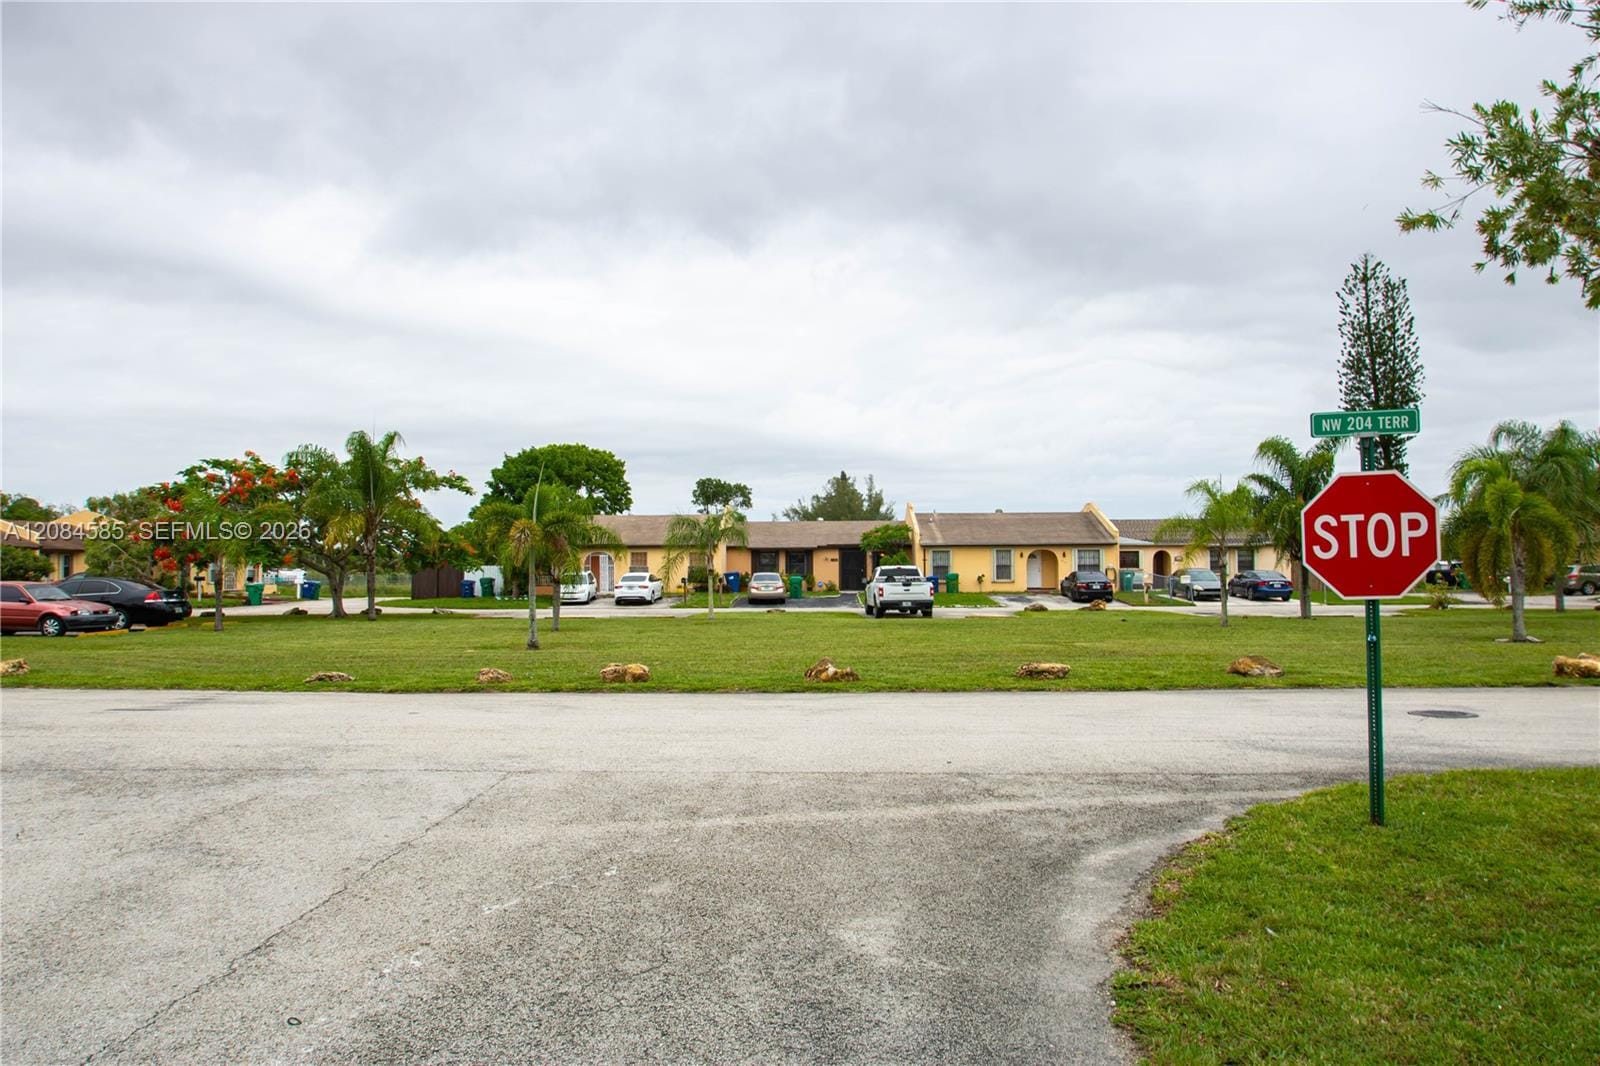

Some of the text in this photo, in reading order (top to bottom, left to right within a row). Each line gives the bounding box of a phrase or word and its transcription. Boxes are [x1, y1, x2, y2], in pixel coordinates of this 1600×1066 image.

[1322, 415, 1410, 431] NW 204 TERR
[1312, 512, 1429, 560] STOP
